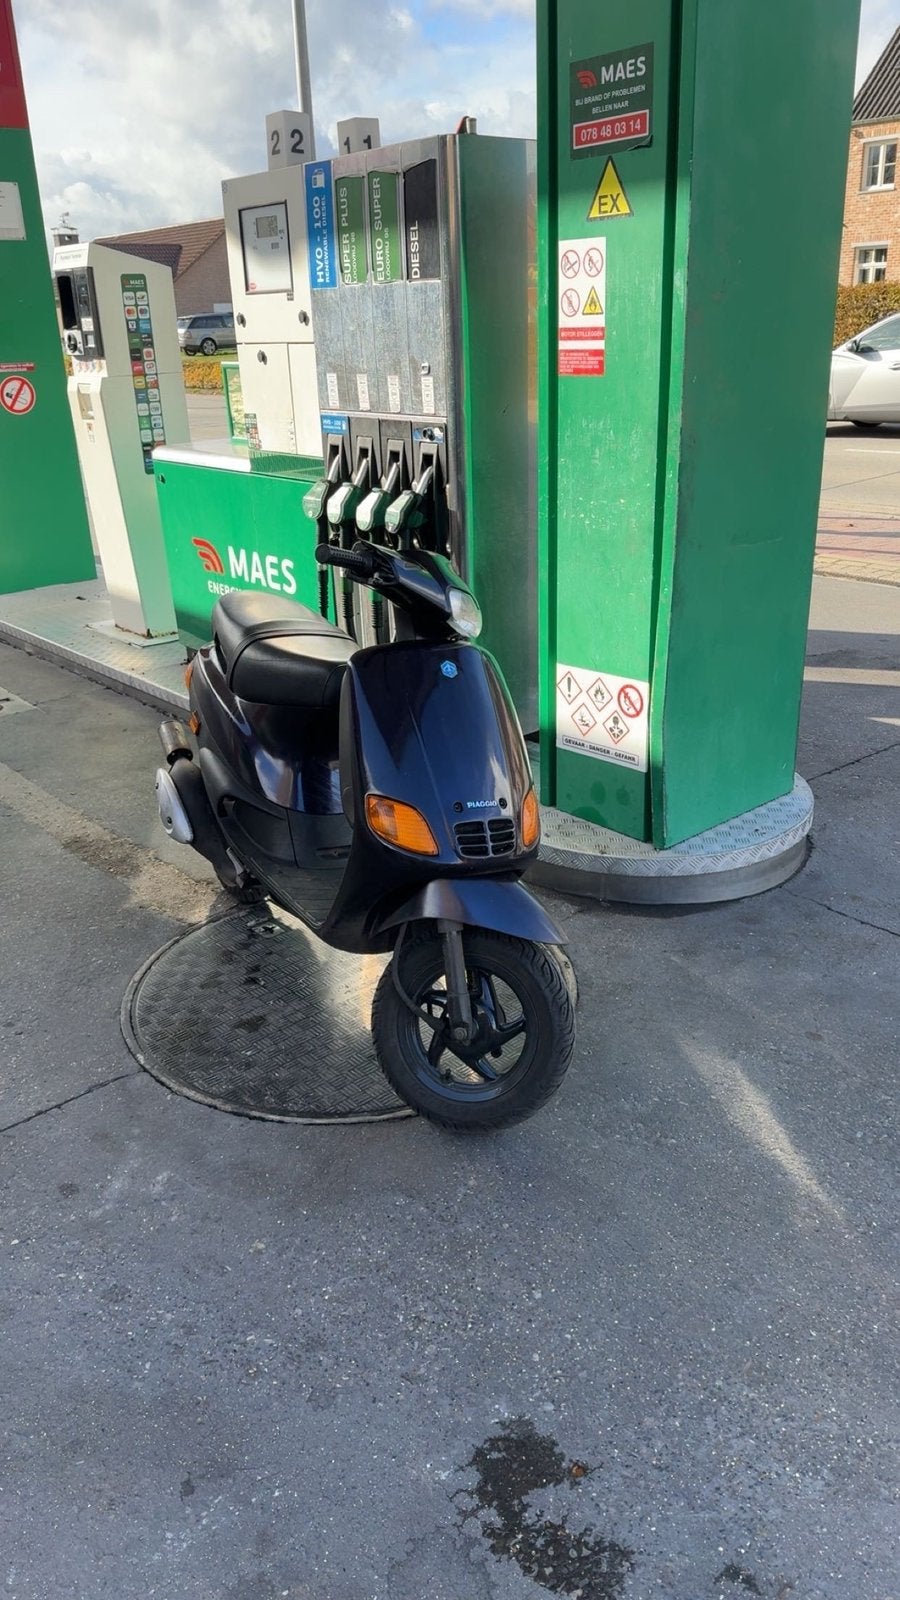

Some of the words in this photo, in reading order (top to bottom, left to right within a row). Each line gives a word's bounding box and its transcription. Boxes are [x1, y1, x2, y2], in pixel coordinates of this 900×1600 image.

[601, 56, 646, 84] MAES
[575, 98, 583, 106] BIJ
[584, 94, 602, 104] BRAND
[603, 91, 611, 99] OF
[611, 84, 645, 98] PROBLEMEN
[592, 103, 613, 114] BELLEN
[613, 100, 629, 110] NAAR
[271, 130, 281, 155] 2
[290, 128, 305, 154] 2
[363, 135, 372, 150] 1
[581, 127, 598, 142] 078
[600, 125, 612, 138] 48
[614, 122, 626, 135] 03
[630, 119, 641, 132] 14
[343, 137, 351, 154] 1
[312, 196, 322, 229] 100
[340, 187, 349, 227] PLUS
[373, 177, 383, 231] SUPER
[598, 192, 621, 214] EX
[322, 229, 330, 283] RENEWABLE
[342, 233, 352, 284] SUPER
[375, 238, 385, 281] EURO
[410, 220, 420, 279] DIESEL
[315, 247, 325, 283] HVO
[227, 545, 297, 595] MAES
[207, 579, 241, 596] ENER
[564, 737, 585, 748] GEVAAR
[589, 744, 610, 755] DANGER
[614, 751, 636, 762] GEFAHR
[467, 800, 497, 809] PIAGGIO
